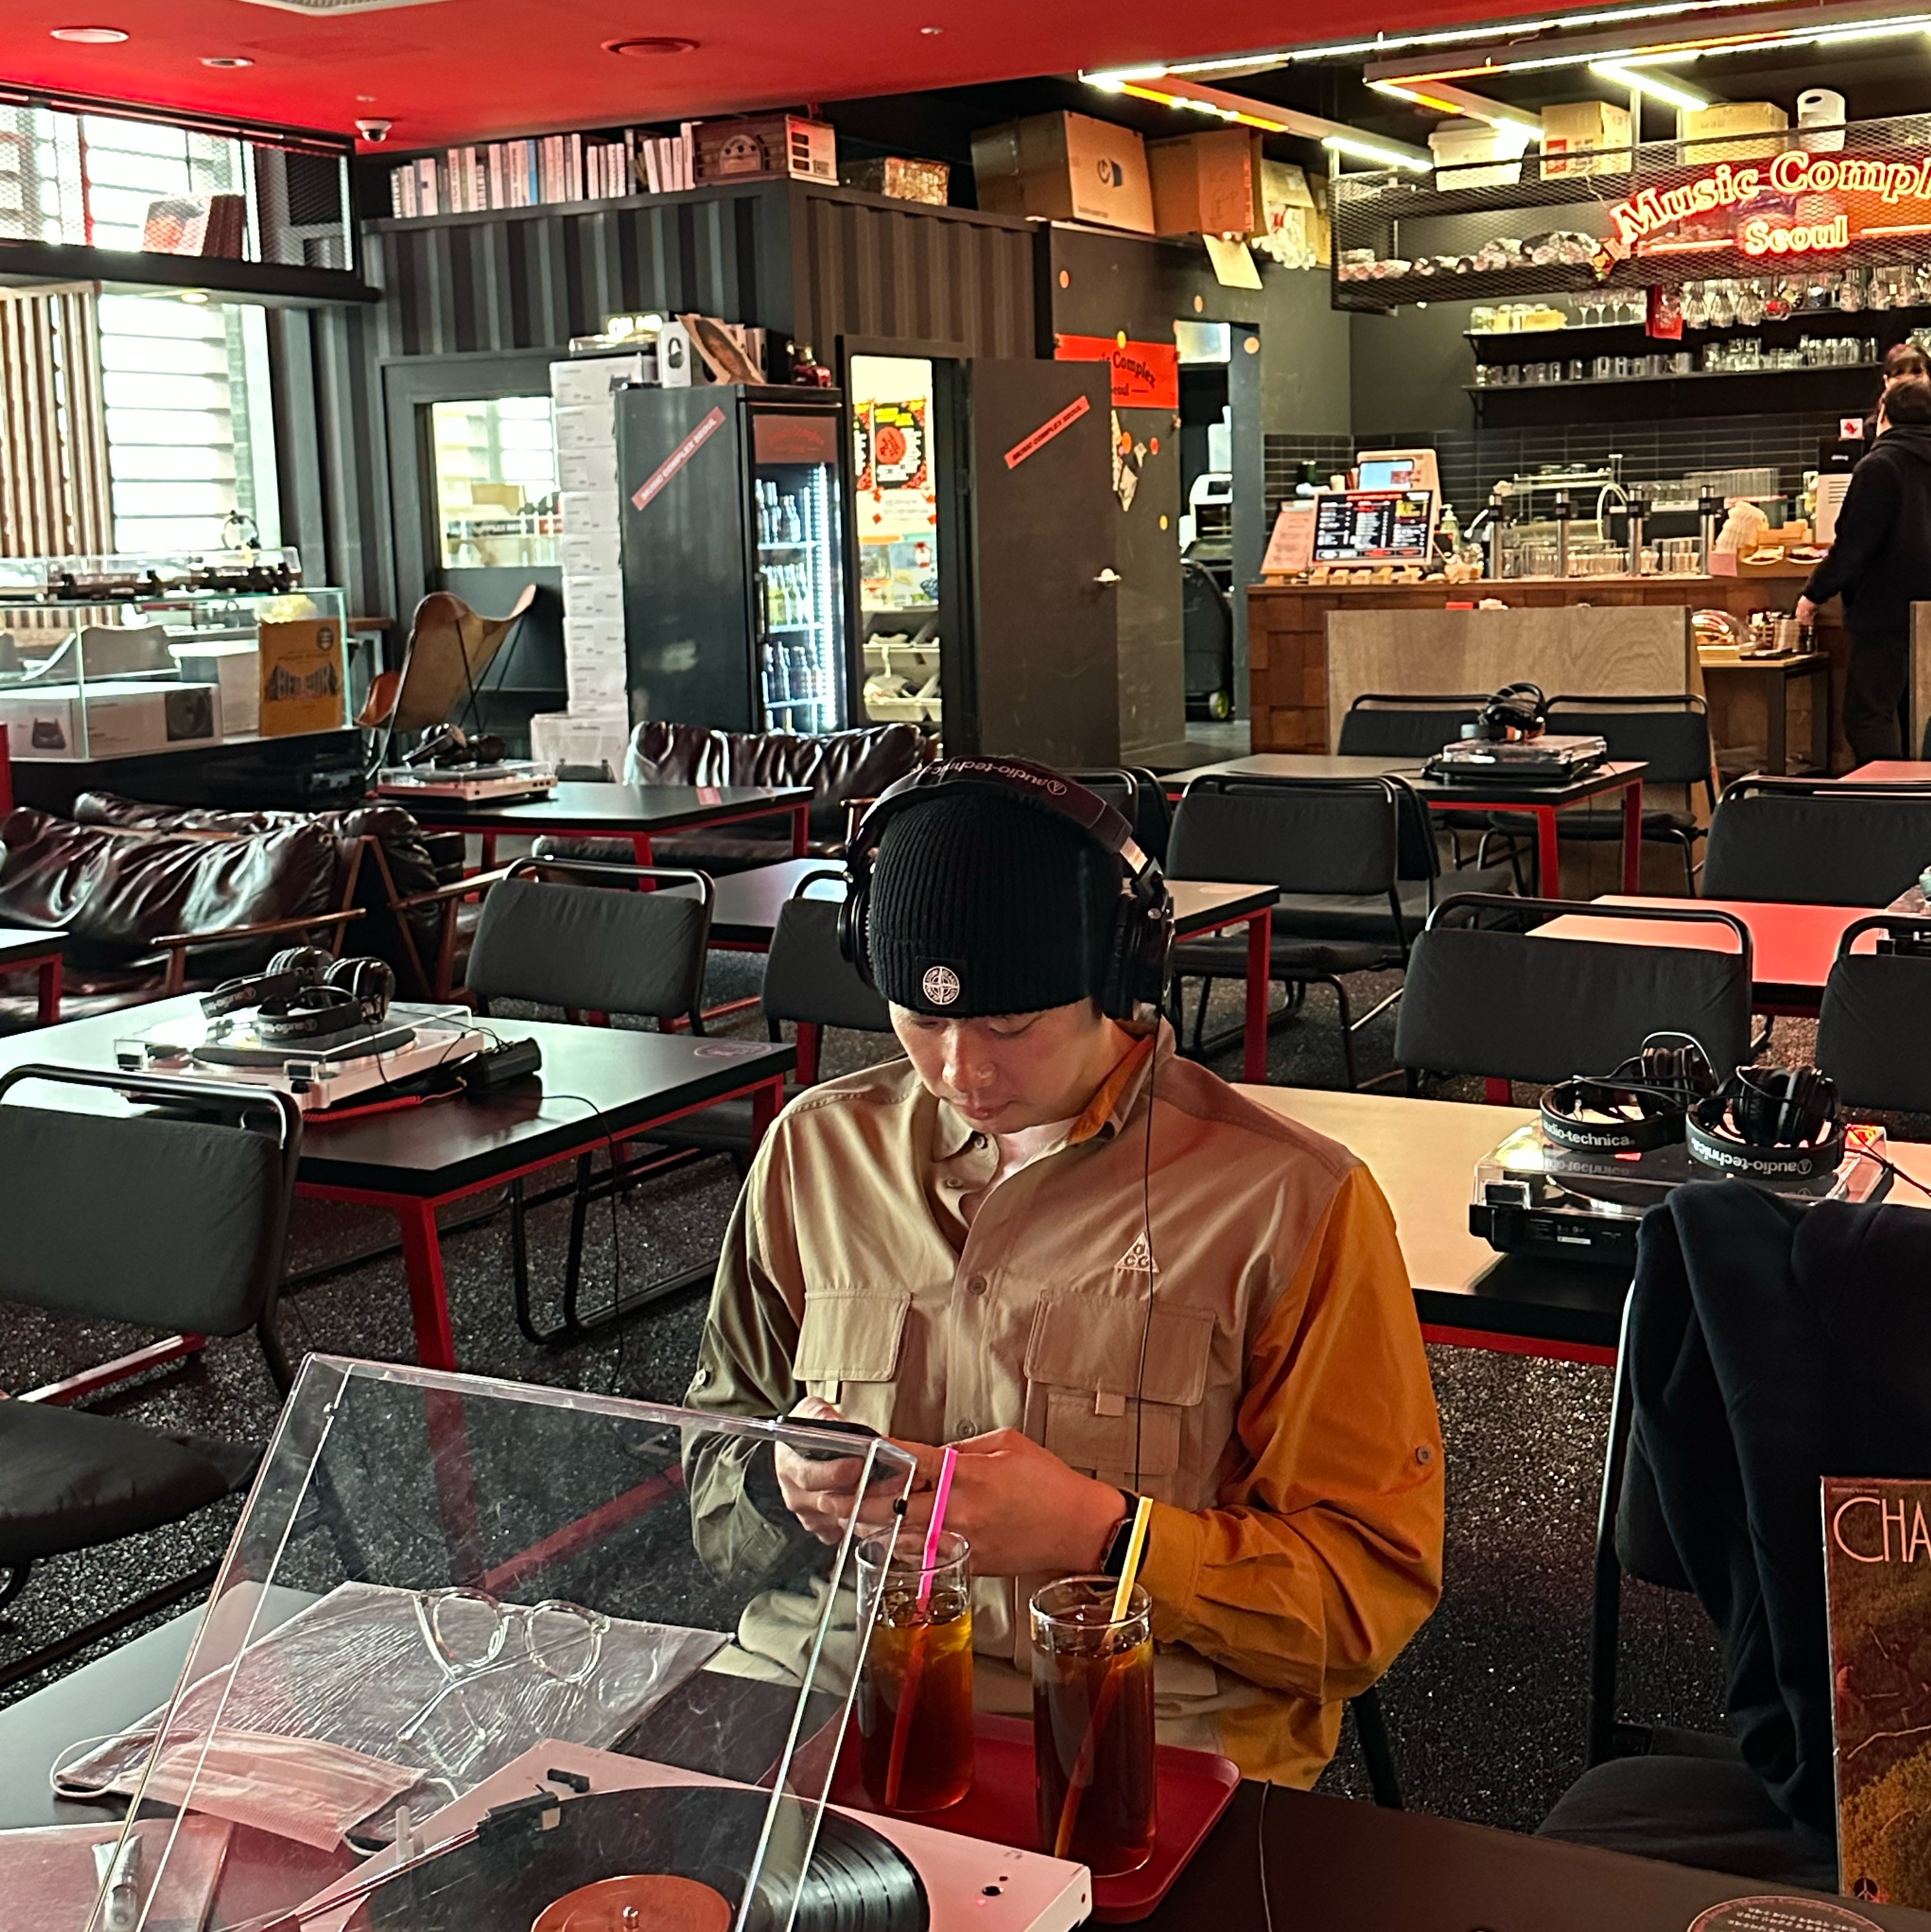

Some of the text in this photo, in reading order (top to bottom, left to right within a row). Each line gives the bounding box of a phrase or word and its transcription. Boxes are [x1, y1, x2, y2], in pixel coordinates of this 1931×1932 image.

[1609, 164, 1761, 245] Music
[1745, 216, 1849, 255] Seoul
[1113, 351, 1156, 388] Complex
[1112, 383, 1130, 396] eoul
[1543, 1119, 1631, 1146] audio-technica
[1692, 1138, 1798, 1175] audio-technica
